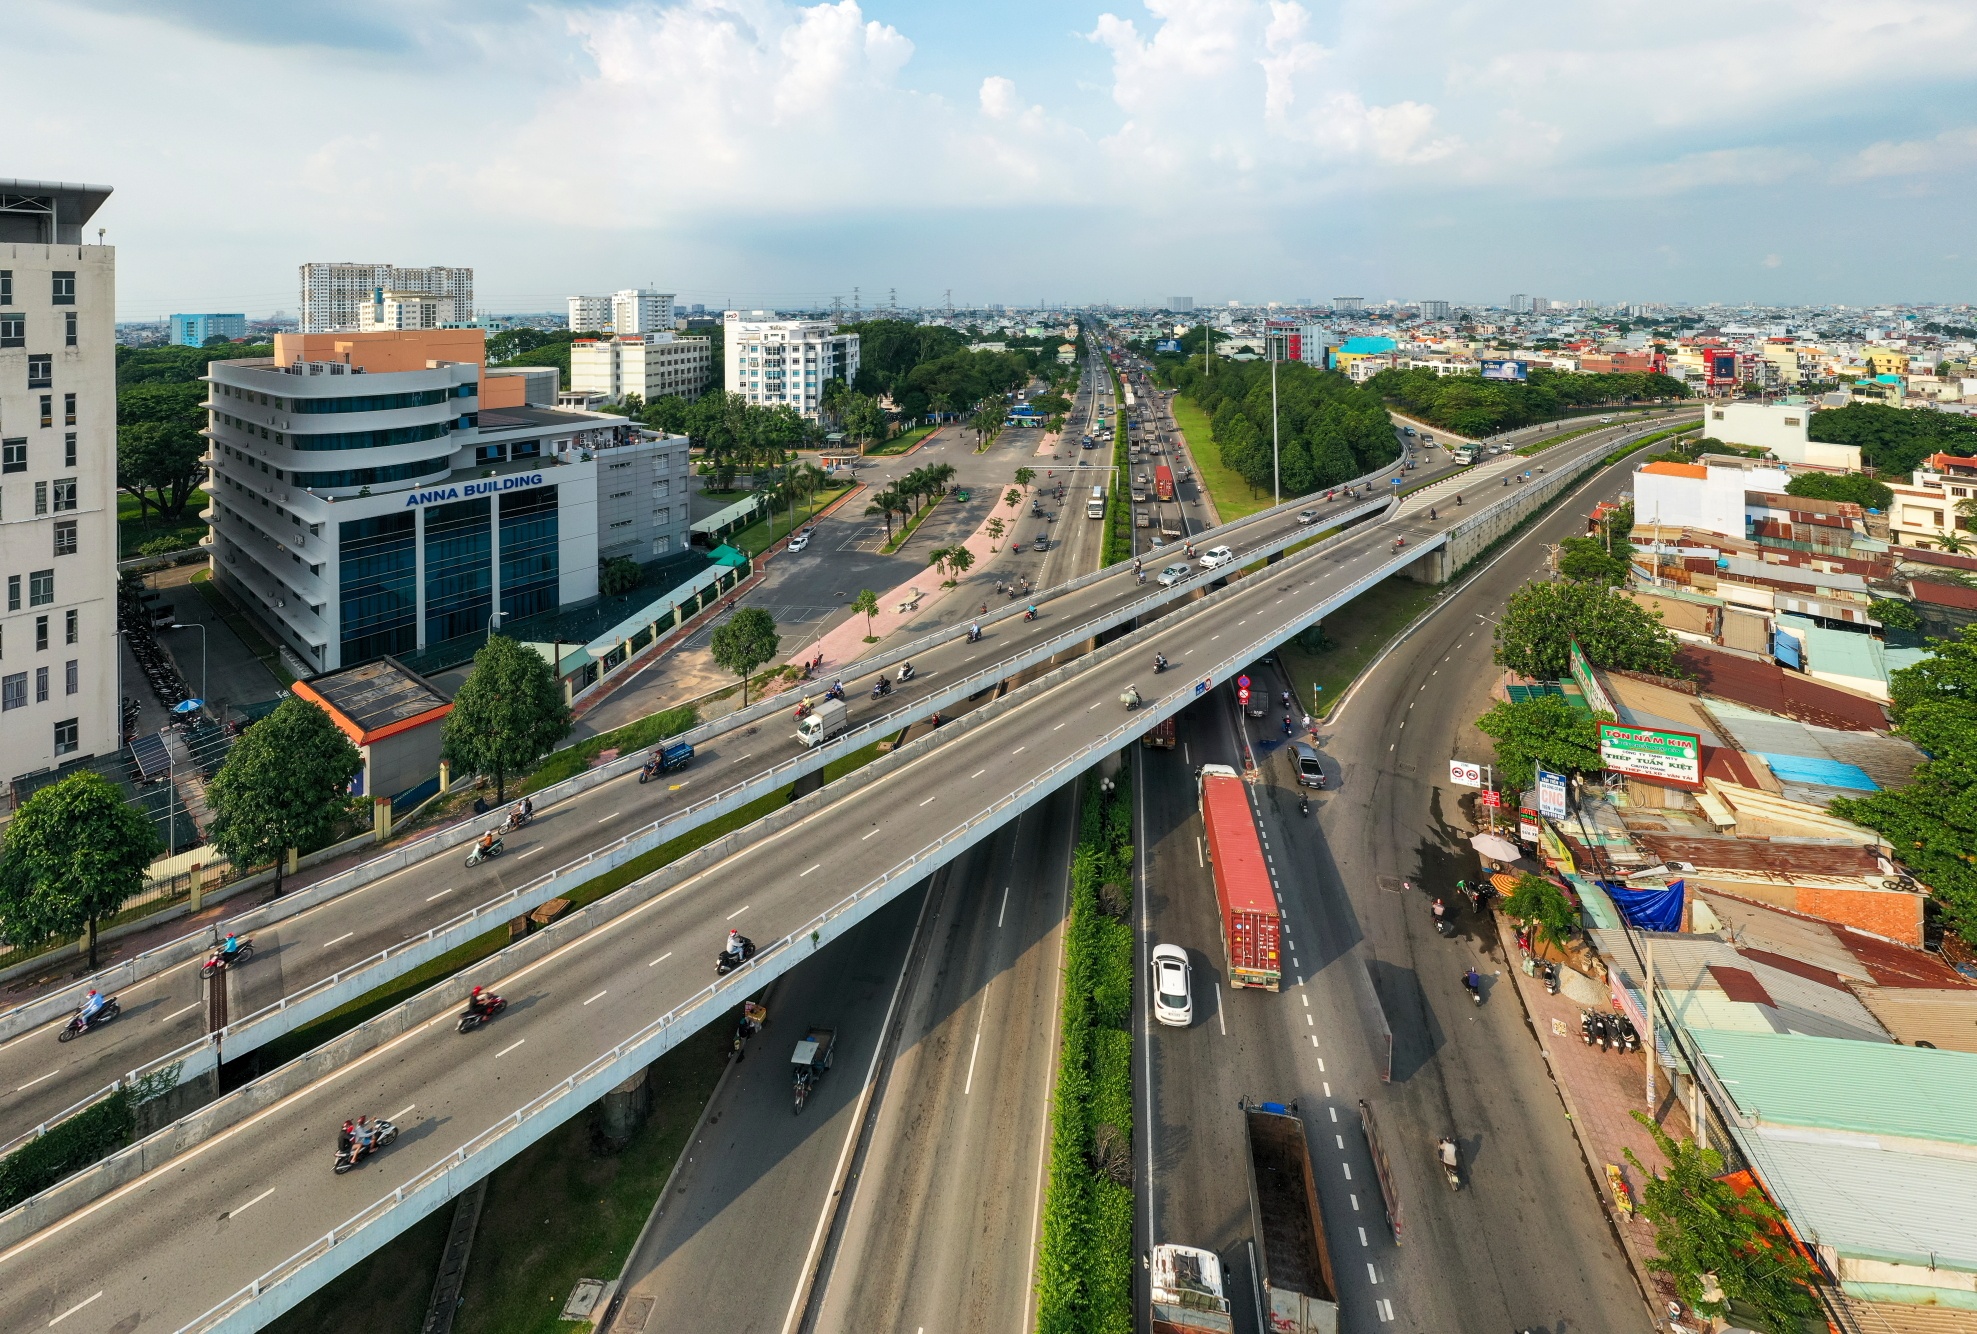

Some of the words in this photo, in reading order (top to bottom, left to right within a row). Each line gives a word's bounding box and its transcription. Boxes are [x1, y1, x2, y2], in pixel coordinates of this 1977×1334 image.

[406, 488, 459, 507] ANNA
[464, 474, 543, 497] BUILDING
[1605, 729, 1631, 740] TÔN
[1668, 739, 1693, 748] KIM
[1606, 753, 1632, 762] THÉP
[1668, 762, 1693, 771] KIỆT
[1541, 788, 1564, 806] CNC
[1521, 808, 1537, 816] HOTEL
